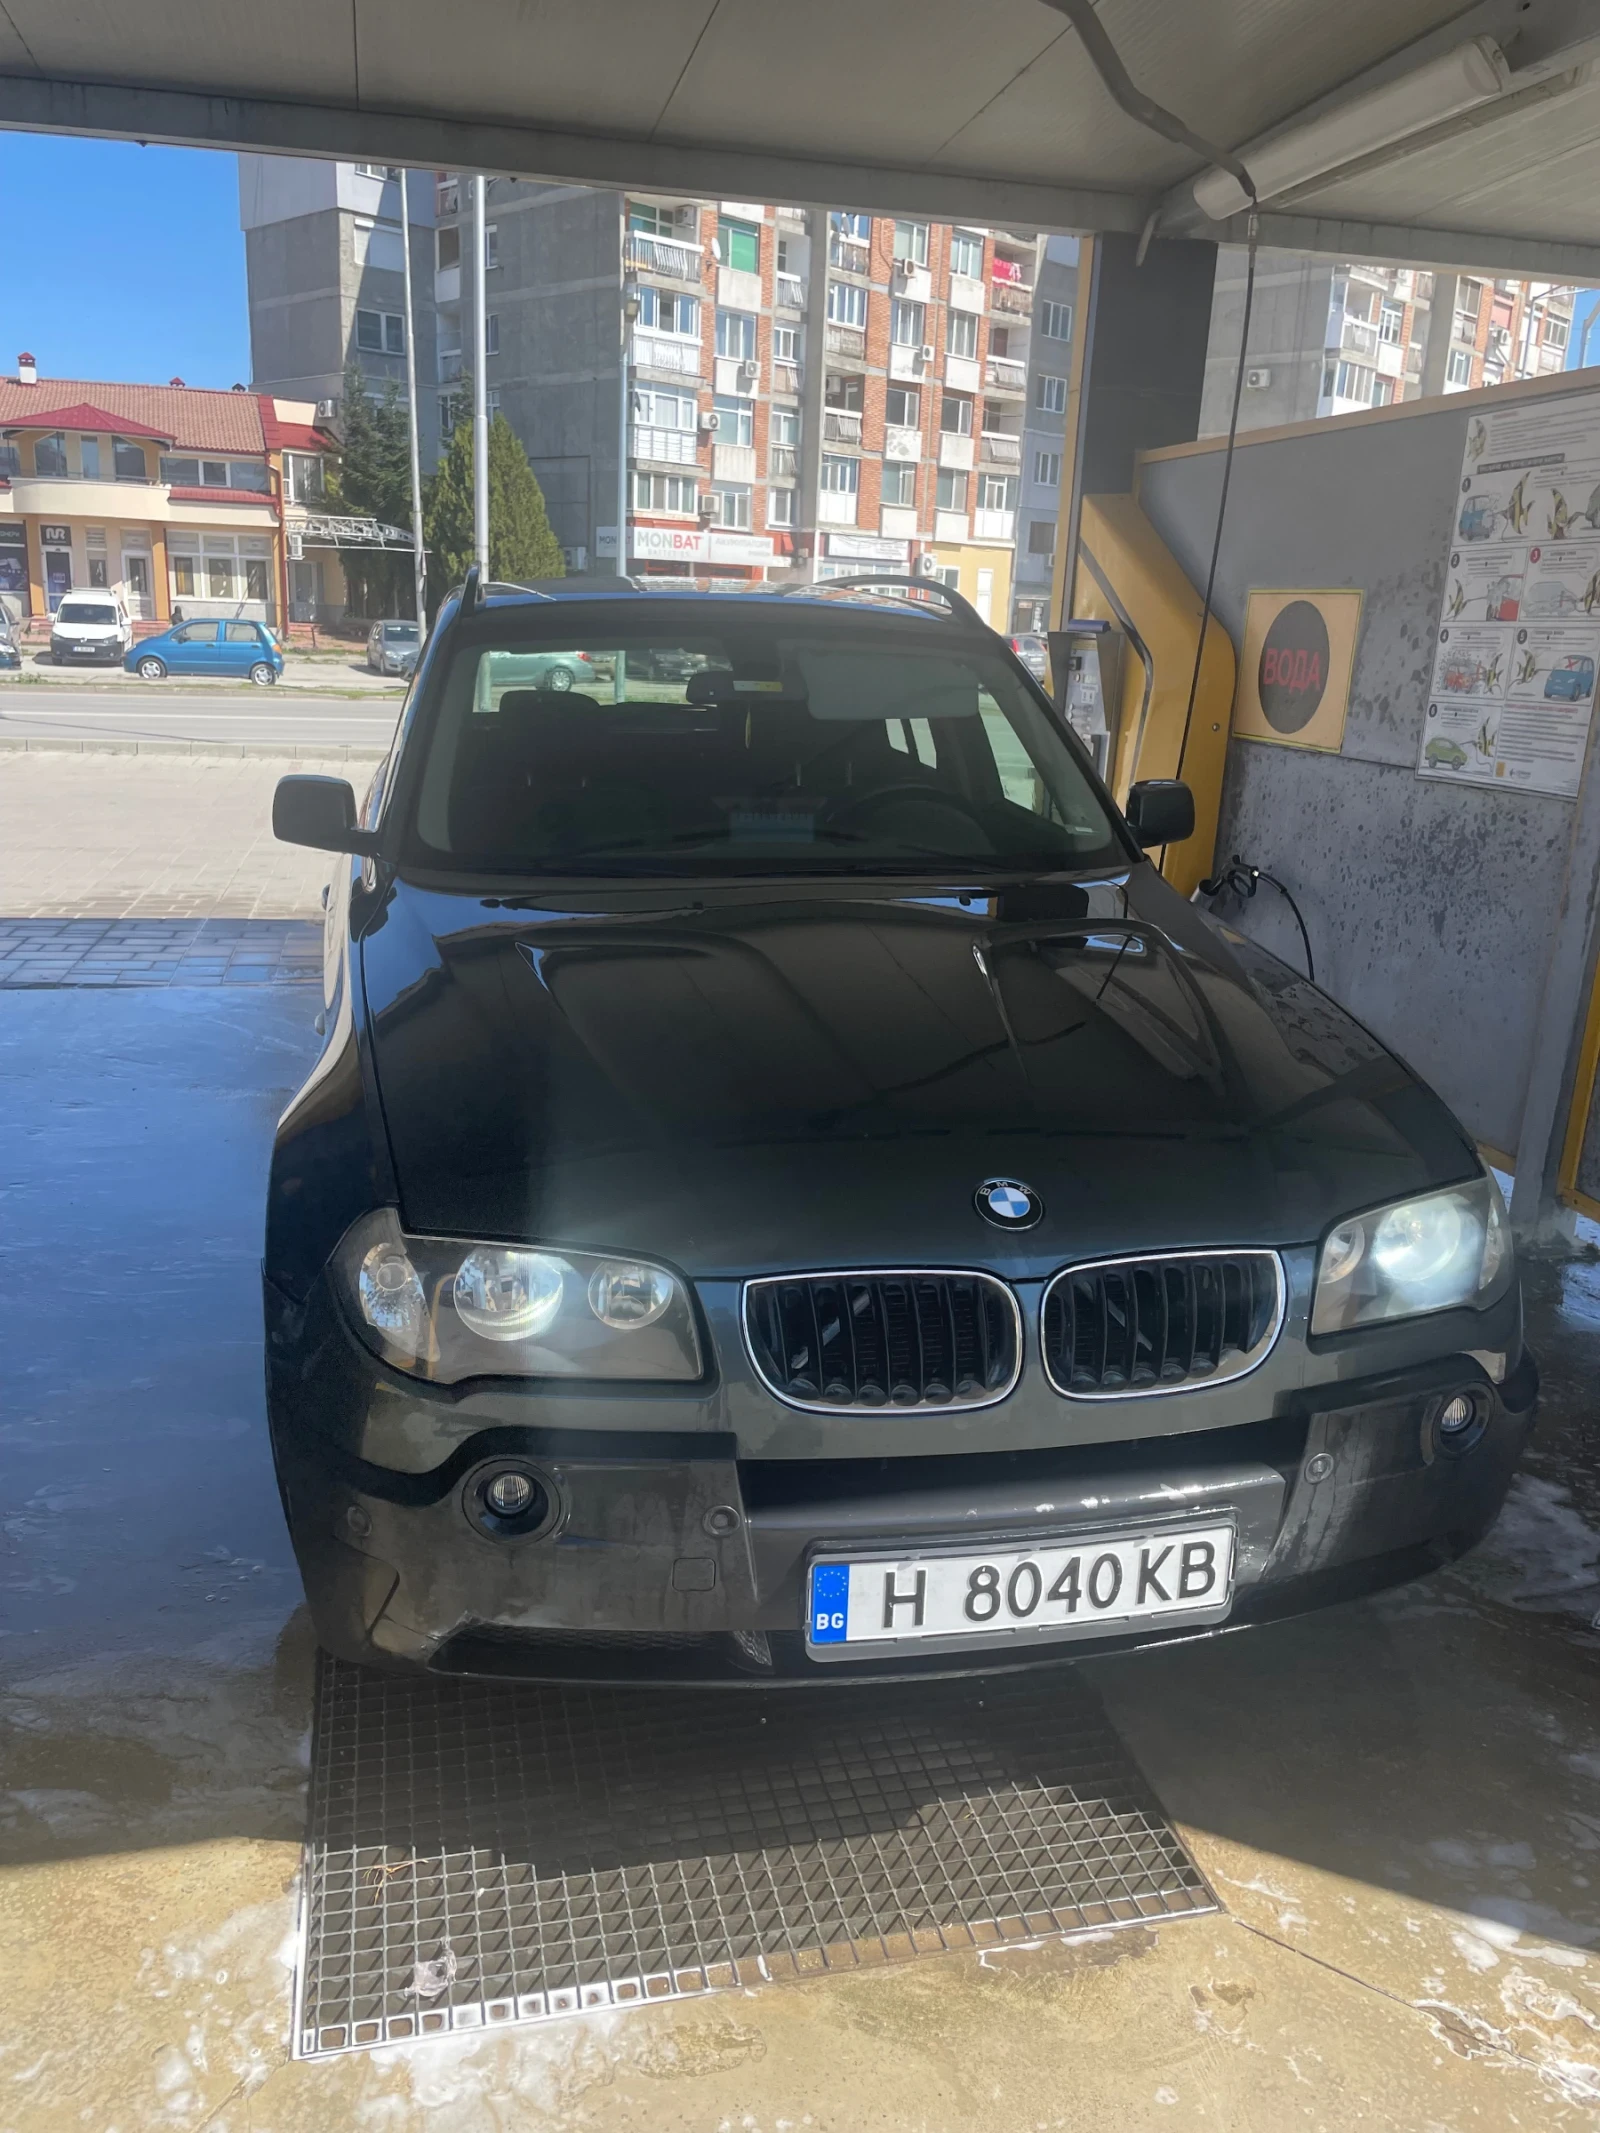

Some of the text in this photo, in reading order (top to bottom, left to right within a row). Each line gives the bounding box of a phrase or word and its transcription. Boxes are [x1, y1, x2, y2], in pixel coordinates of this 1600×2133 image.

[599, 535, 632, 545] MONT
[637, 531, 702, 550] MONBAT
[1263, 648, 1321, 695] ВОДА
[979, 1181, 1032, 1196] BMW
[882, 1568, 927, 1628] H
[816, 1612, 845, 1630] BG
